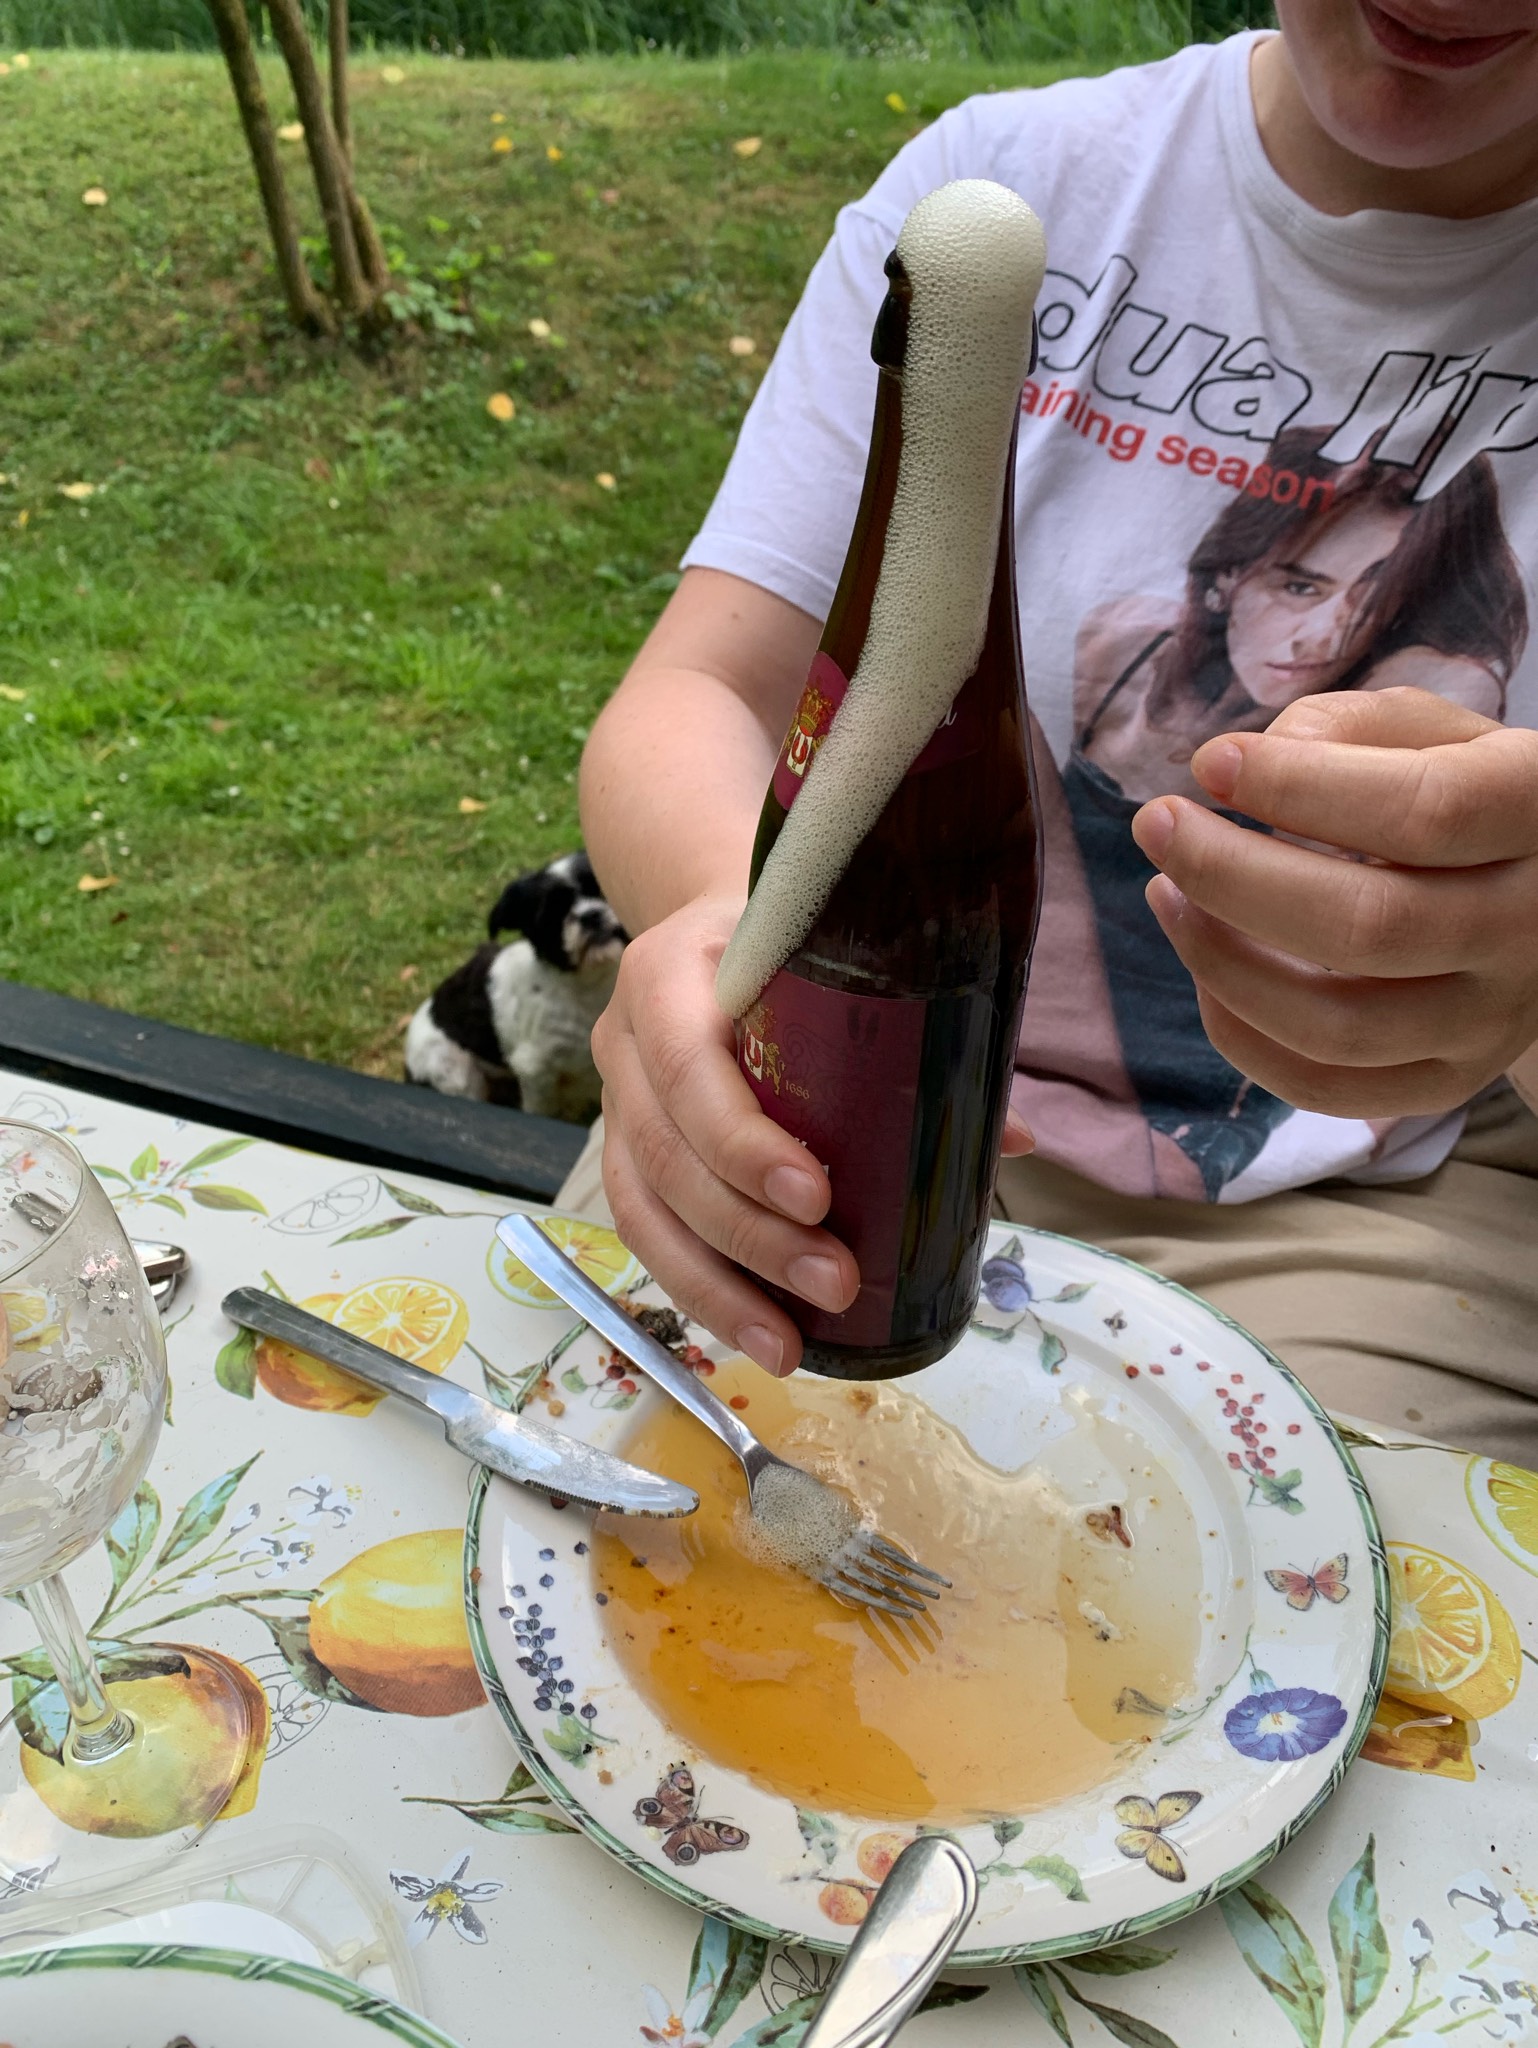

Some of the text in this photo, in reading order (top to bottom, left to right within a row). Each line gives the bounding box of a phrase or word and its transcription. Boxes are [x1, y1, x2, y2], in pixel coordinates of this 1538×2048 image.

[1037, 254, 1312, 442] dua
[1021, 378, 1335, 513] aining season
